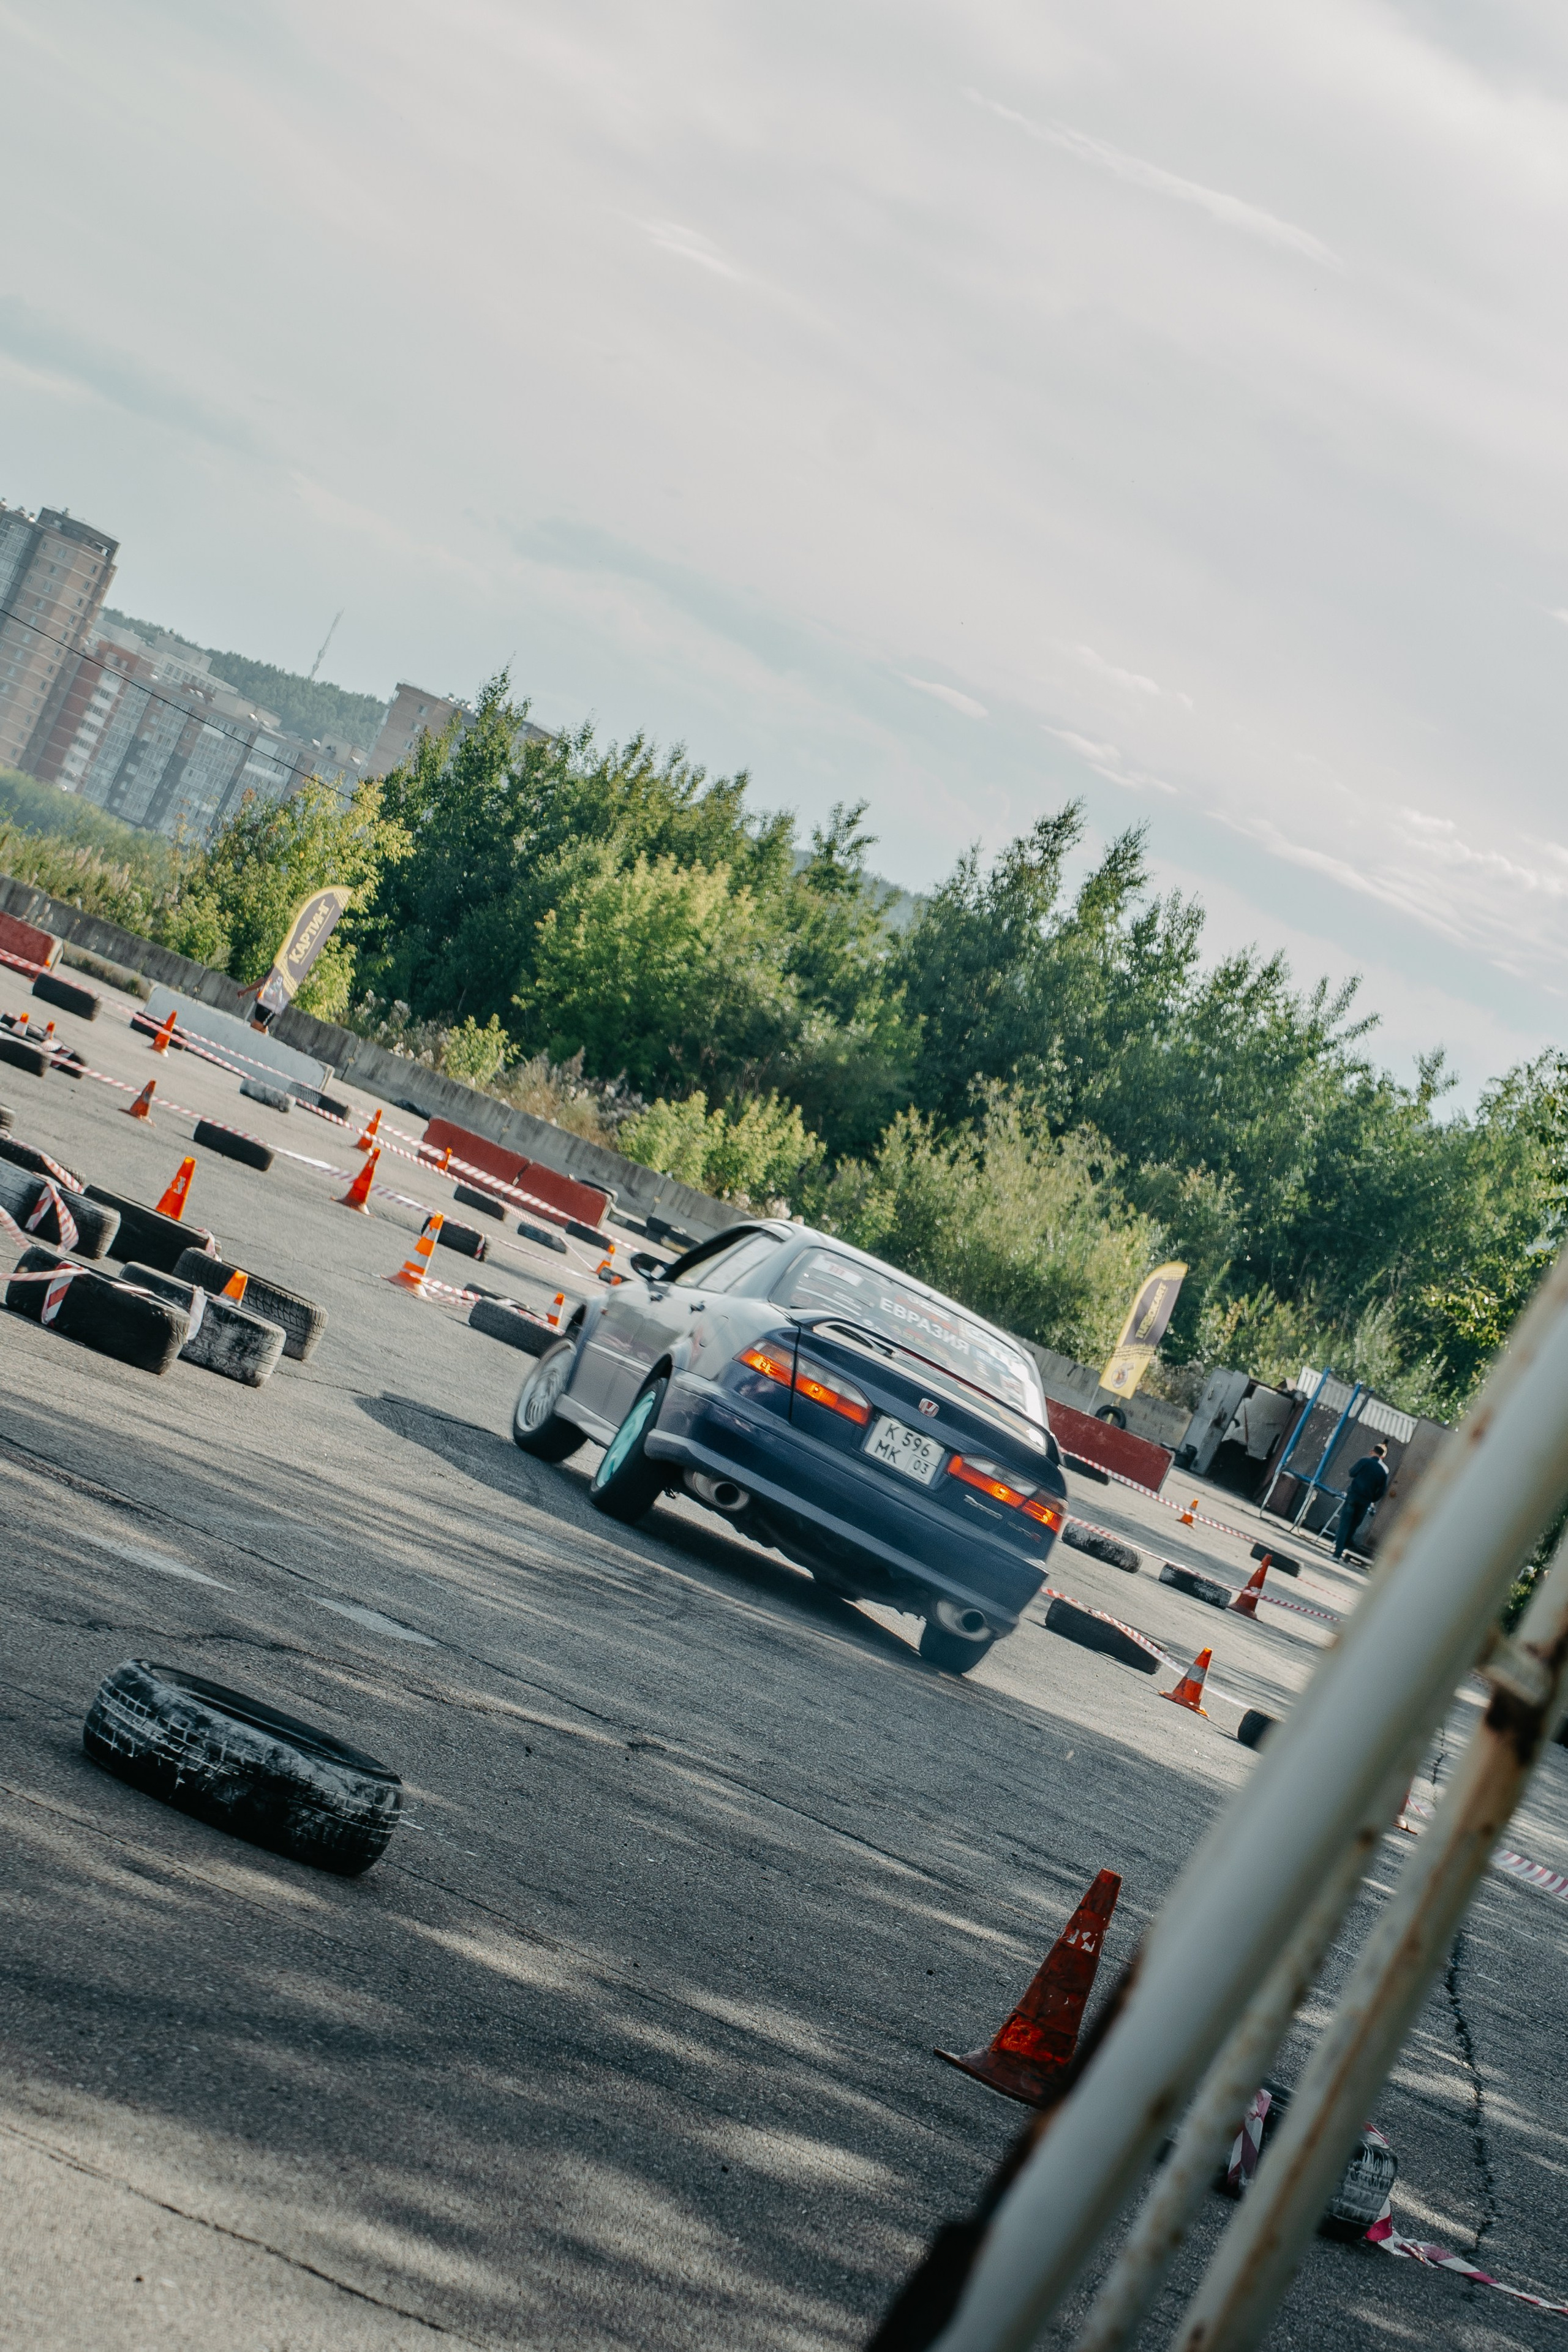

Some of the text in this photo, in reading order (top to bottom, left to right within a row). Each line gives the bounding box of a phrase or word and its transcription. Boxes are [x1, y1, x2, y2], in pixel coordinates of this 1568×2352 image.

[288, 898, 330, 965] КАРТИНГ
[880, 1296, 971, 1355] ЕВРАЗИЯ
[1135, 1281, 1167, 1340] TURBOKART
[874, 1439, 929, 1474] МК 03
[885, 1423, 932, 1457] К 596
